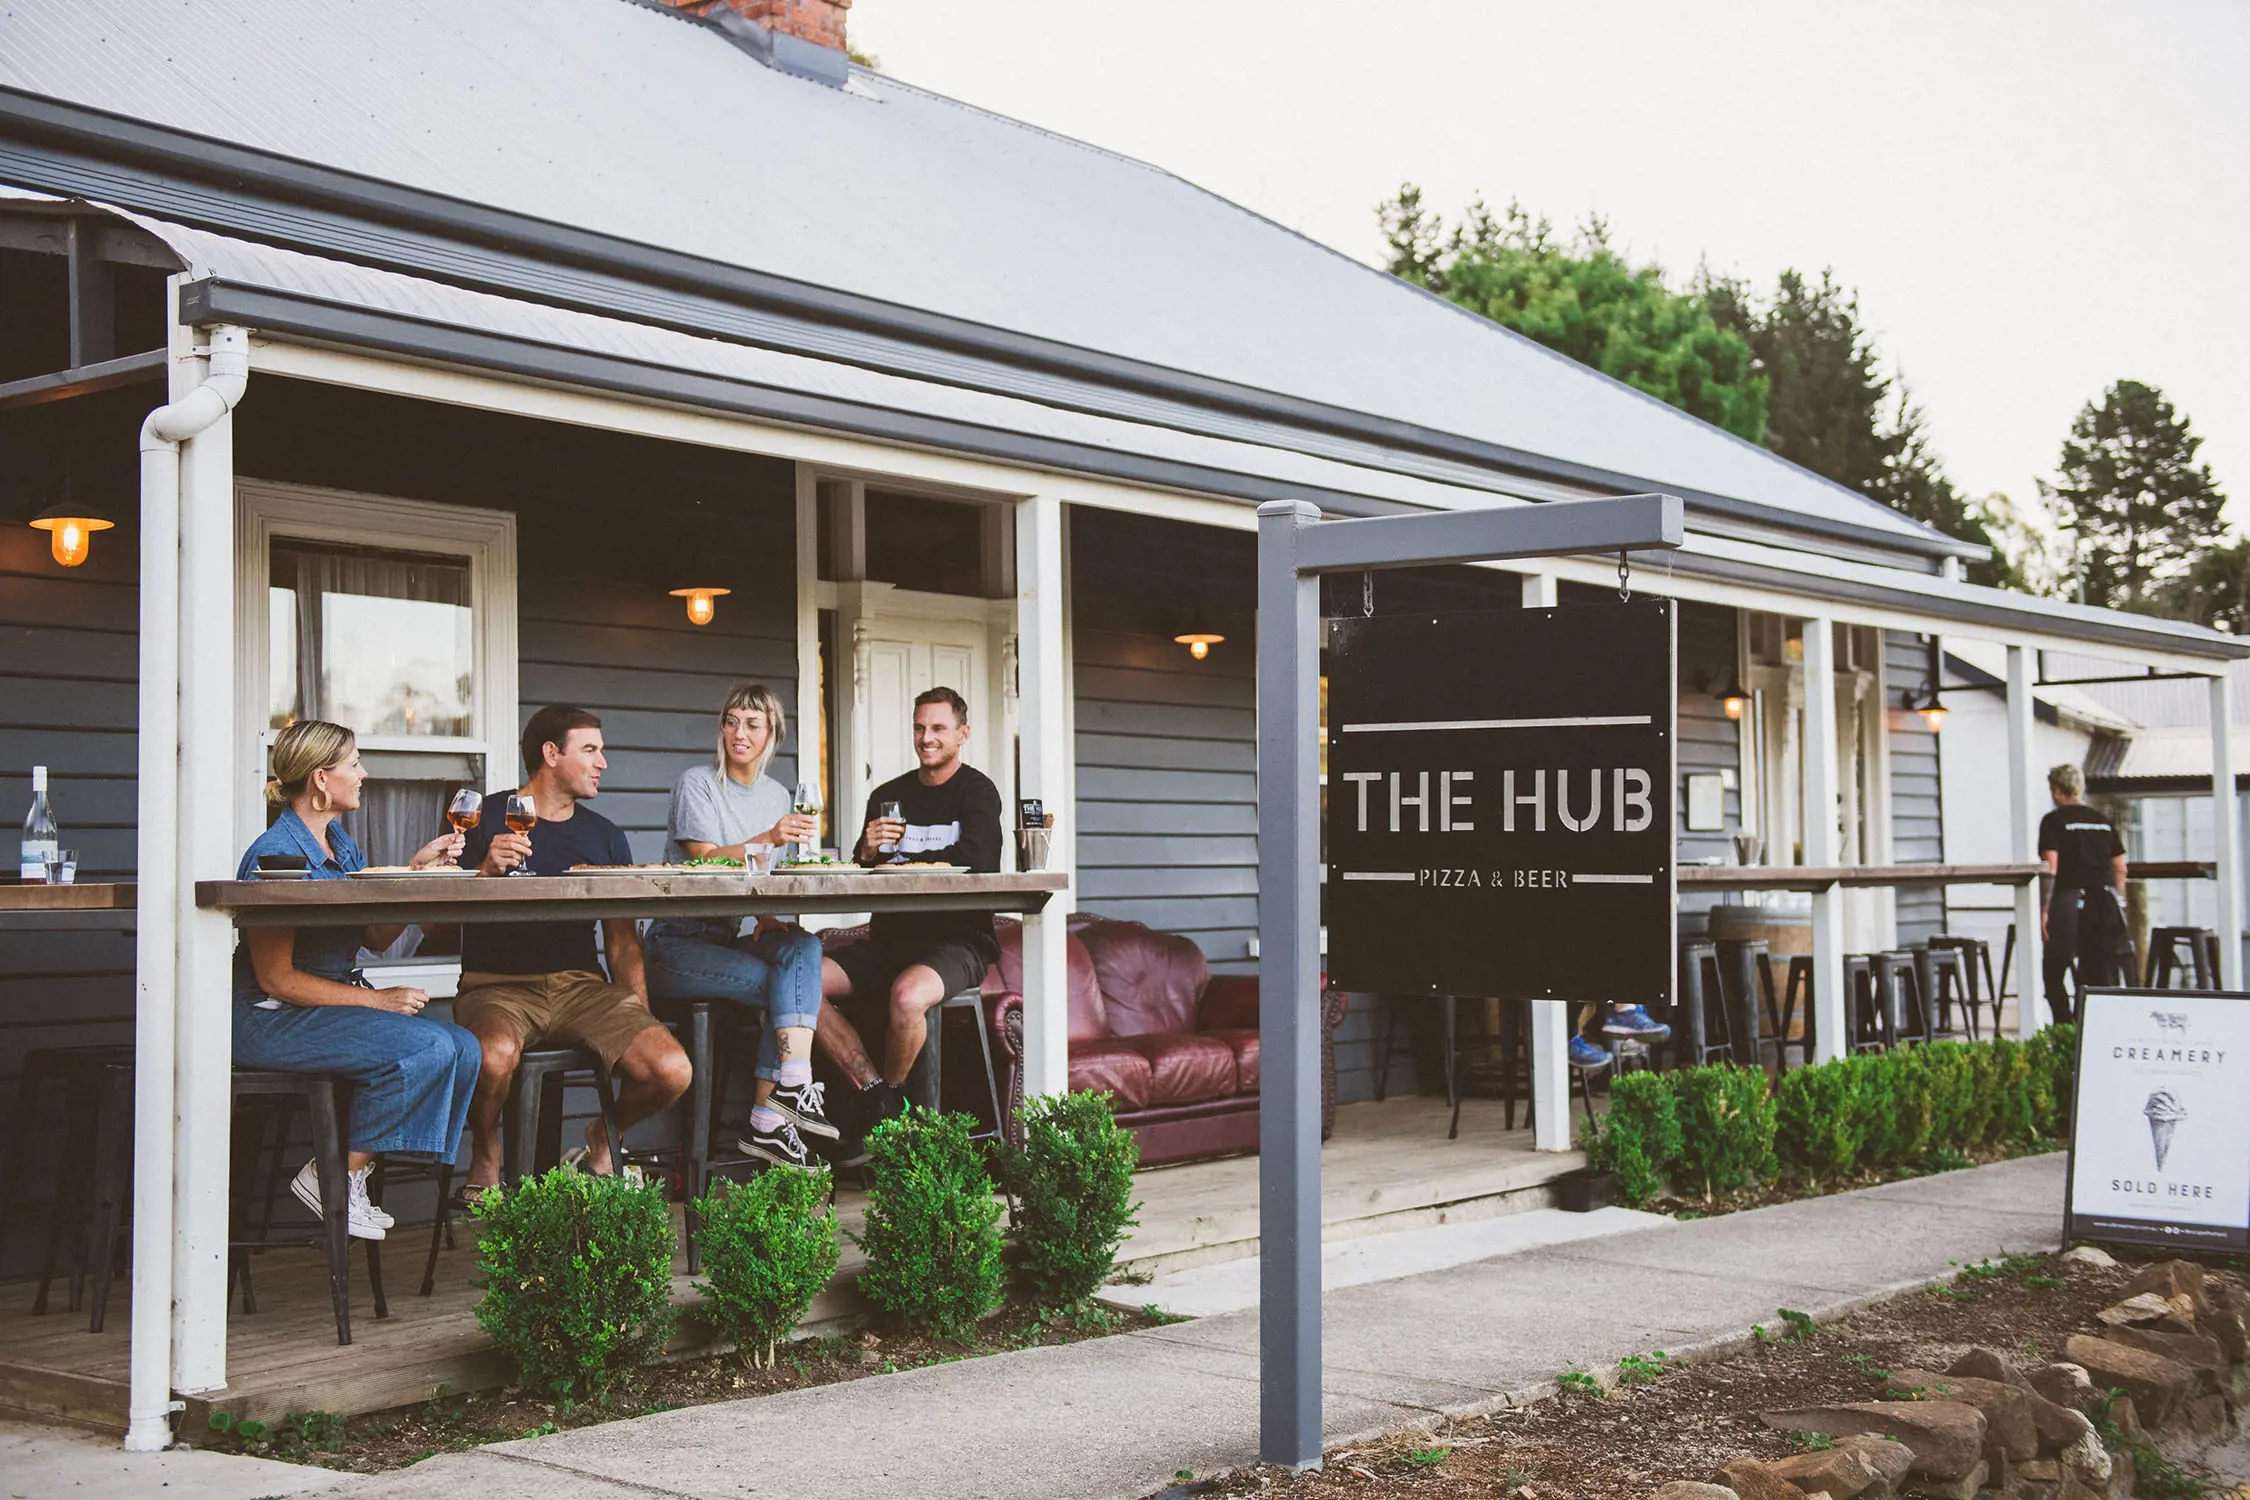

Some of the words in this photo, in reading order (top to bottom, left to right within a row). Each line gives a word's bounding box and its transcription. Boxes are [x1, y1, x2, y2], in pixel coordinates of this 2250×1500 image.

[1342, 771, 1475, 832] THE
[1503, 768, 1653, 832] HUB
[1420, 869, 1481, 887] PIZZA
[1491, 870, 1503, 887] &
[1514, 869, 1568, 888] BEER
[2112, 1046, 2226, 1064] CREAMERY
[2111, 1179, 2157, 1194] SOLD
[2168, 1183, 2214, 1199] HERE
